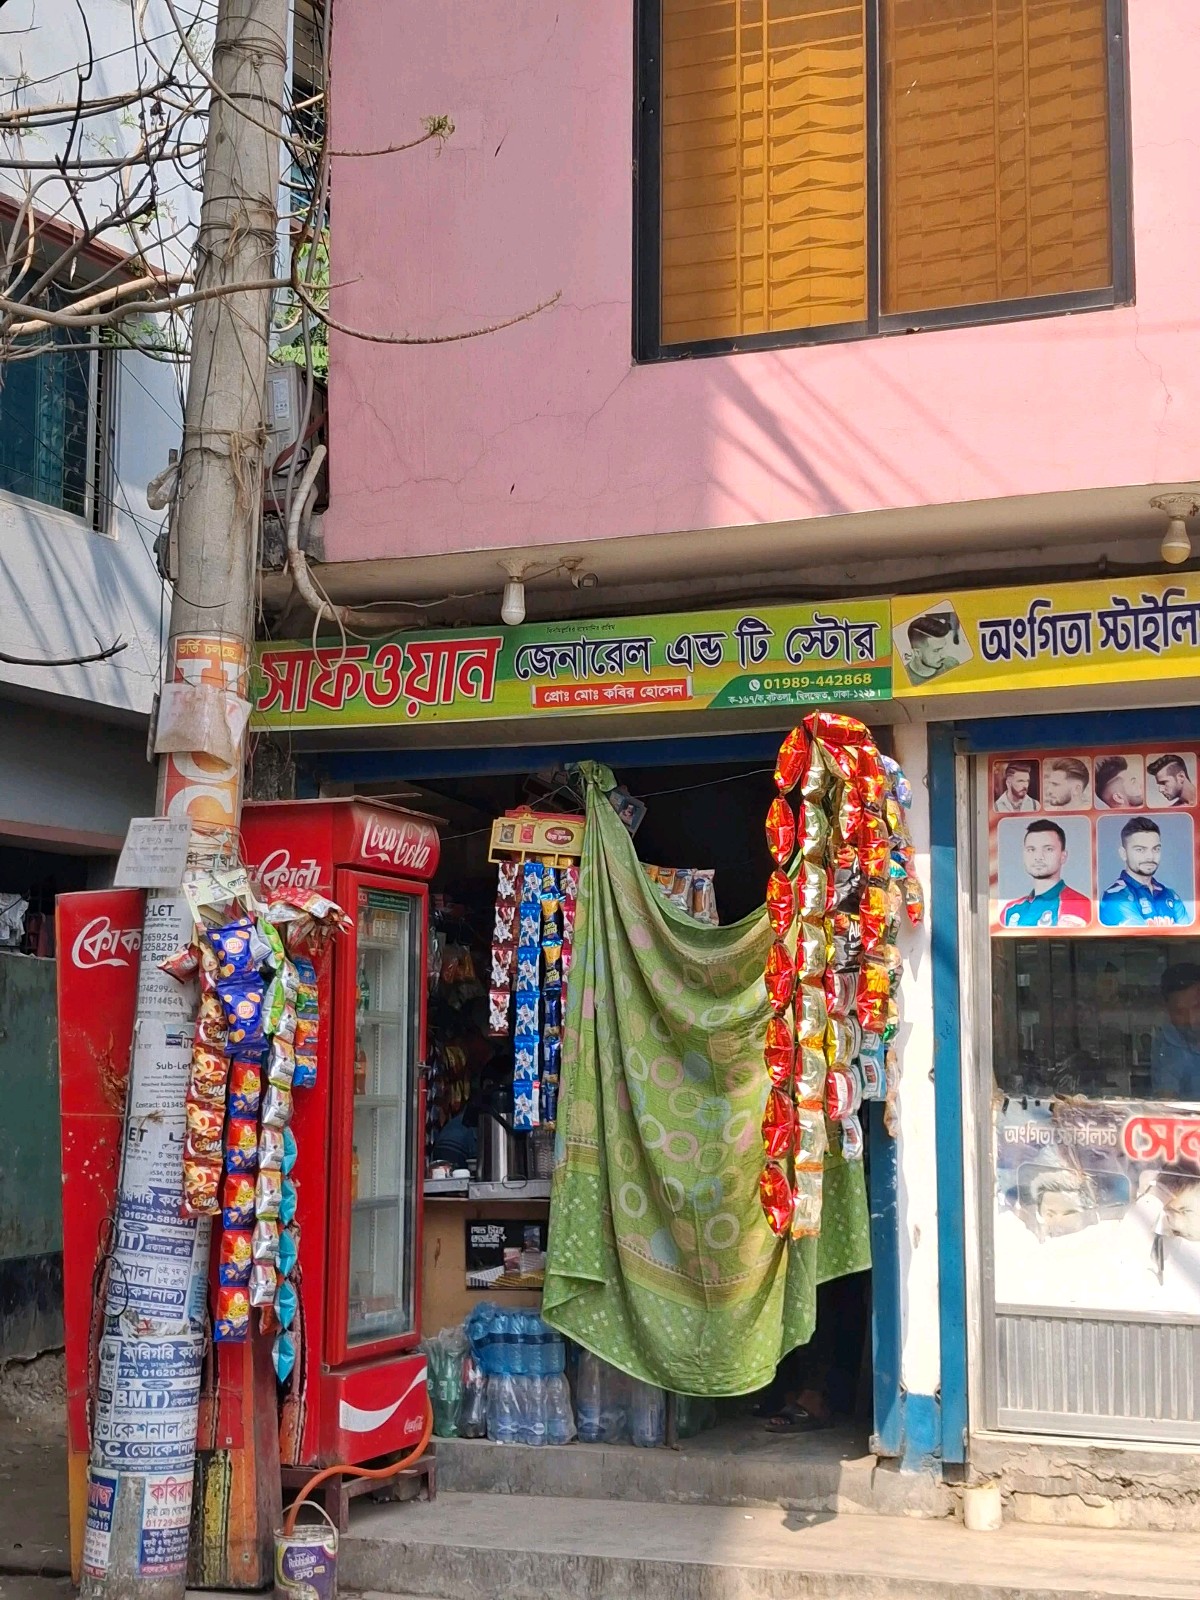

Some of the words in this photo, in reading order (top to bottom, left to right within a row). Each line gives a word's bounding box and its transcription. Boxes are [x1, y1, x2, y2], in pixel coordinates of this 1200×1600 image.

[977, 599, 1096, 663] অংগিতা
[1097, 587, 1200, 656] স্টাইলি
[178, 639, 201, 655] ভর্তি
[256, 636, 504, 718] সাফওয়ান
[513, 636, 656, 682] জেনারেল
[665, 632, 728, 673] এন্ড
[734, 616, 775, 670] টি
[786, 611, 881, 665] স্টোর
[763, 673, 872, 690] 01989-442868
[544, 689, 570, 703] প্রোঃ
[574, 687, 599, 701] মোঃ
[602, 684, 635, 700] কবির
[640, 684, 684, 699] হোসেন
[1003, 1119, 1055, 1145] অংগিতা
